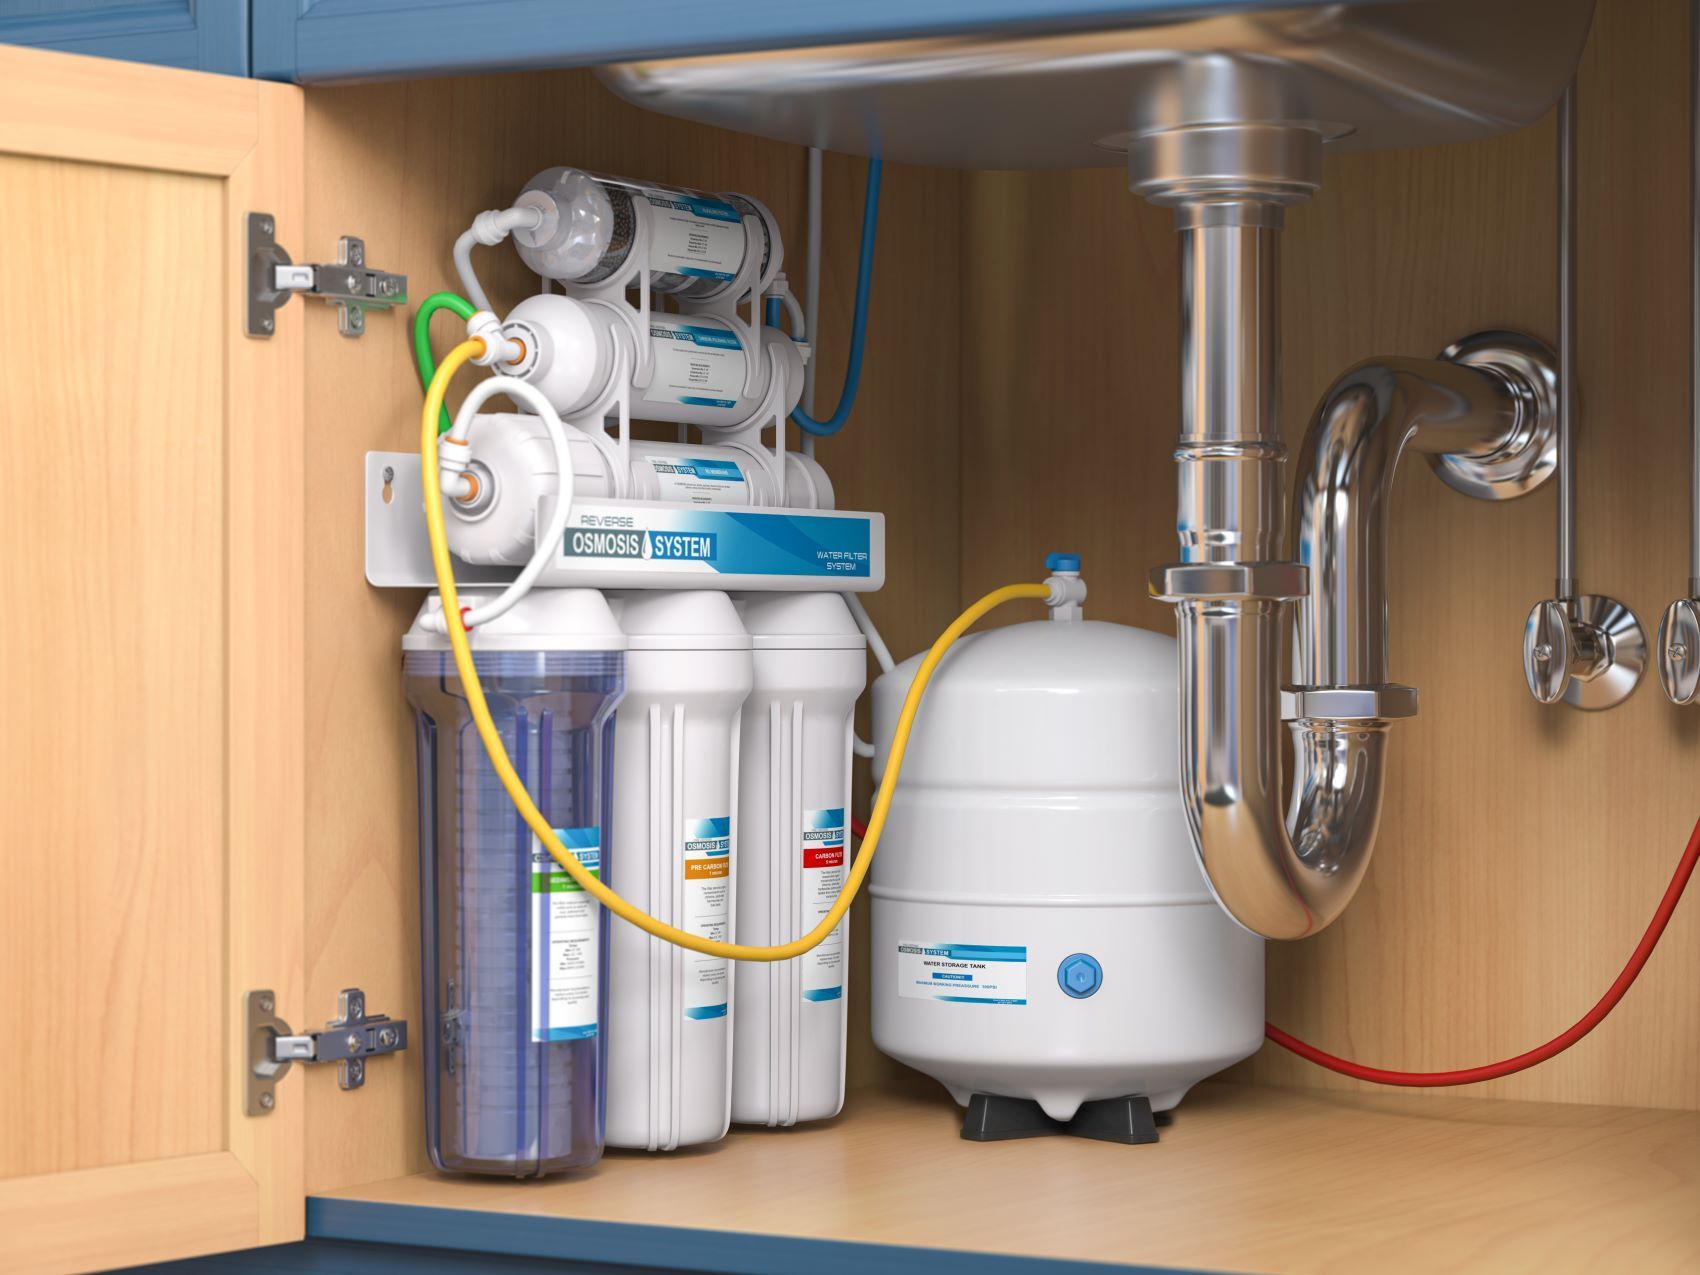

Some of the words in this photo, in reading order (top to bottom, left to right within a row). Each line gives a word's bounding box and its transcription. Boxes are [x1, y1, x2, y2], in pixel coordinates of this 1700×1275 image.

[580, 514, 634, 528] REVERSE
[572, 532, 640, 555] OSMOSIS
[655, 535, 711, 558] SYSTEM
[817, 551, 843, 560] WATER
[844, 552, 868, 560] FILTER
[826, 562, 857, 571] SYSTEM
[805, 831, 832, 840] OSMOSIS
[687, 841, 715, 850] OSMOSIS
[815, 852, 835, 860] CARBON
[703, 863, 722, 871] CARBON
